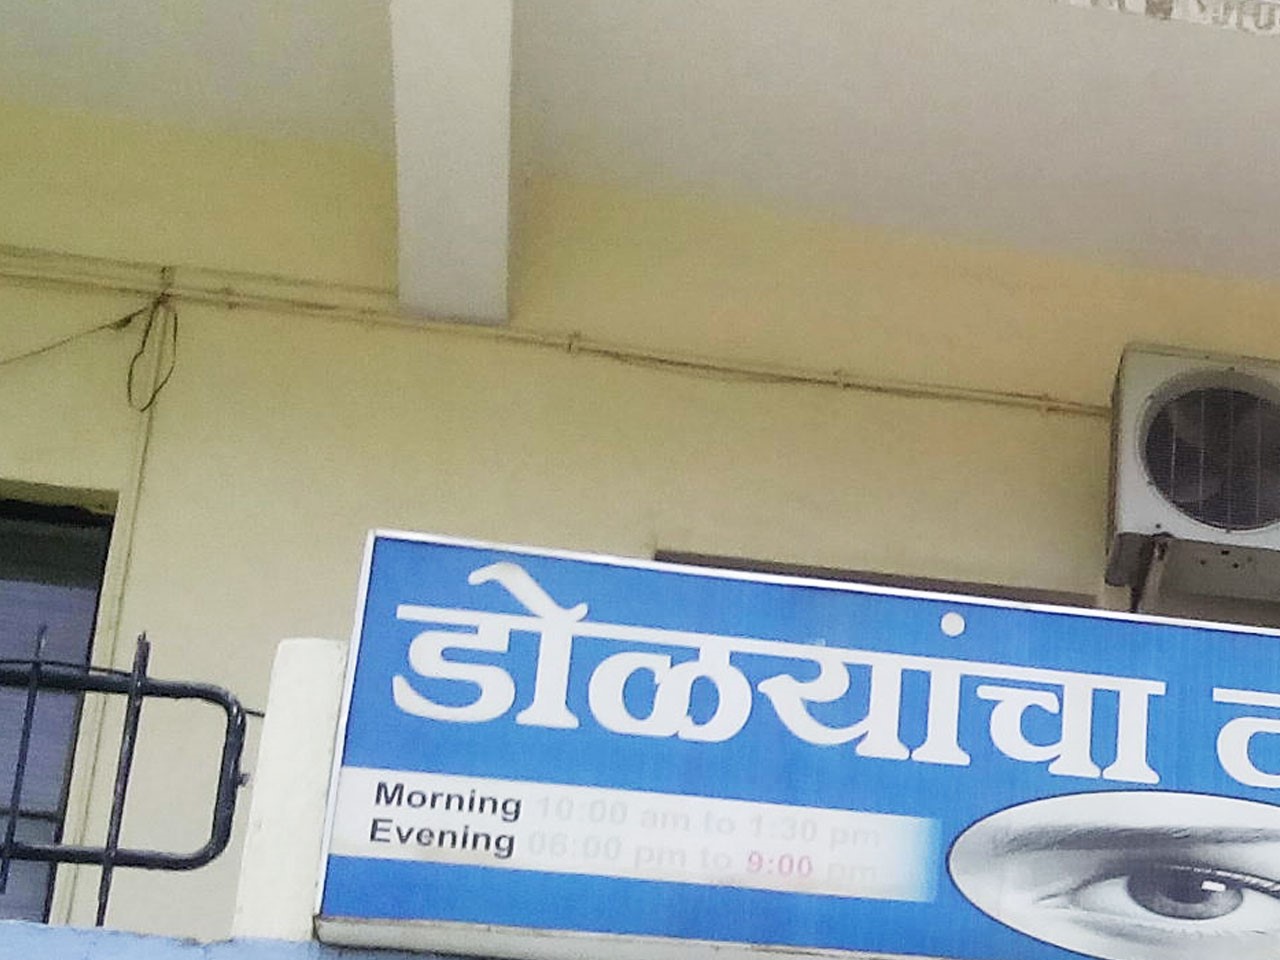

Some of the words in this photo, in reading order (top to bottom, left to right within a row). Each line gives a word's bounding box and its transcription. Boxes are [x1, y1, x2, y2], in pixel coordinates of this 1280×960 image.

[374, 781, 523, 823] Morning
[369, 818, 516, 860] Evening
[748, 850, 814, 878] 9:00
